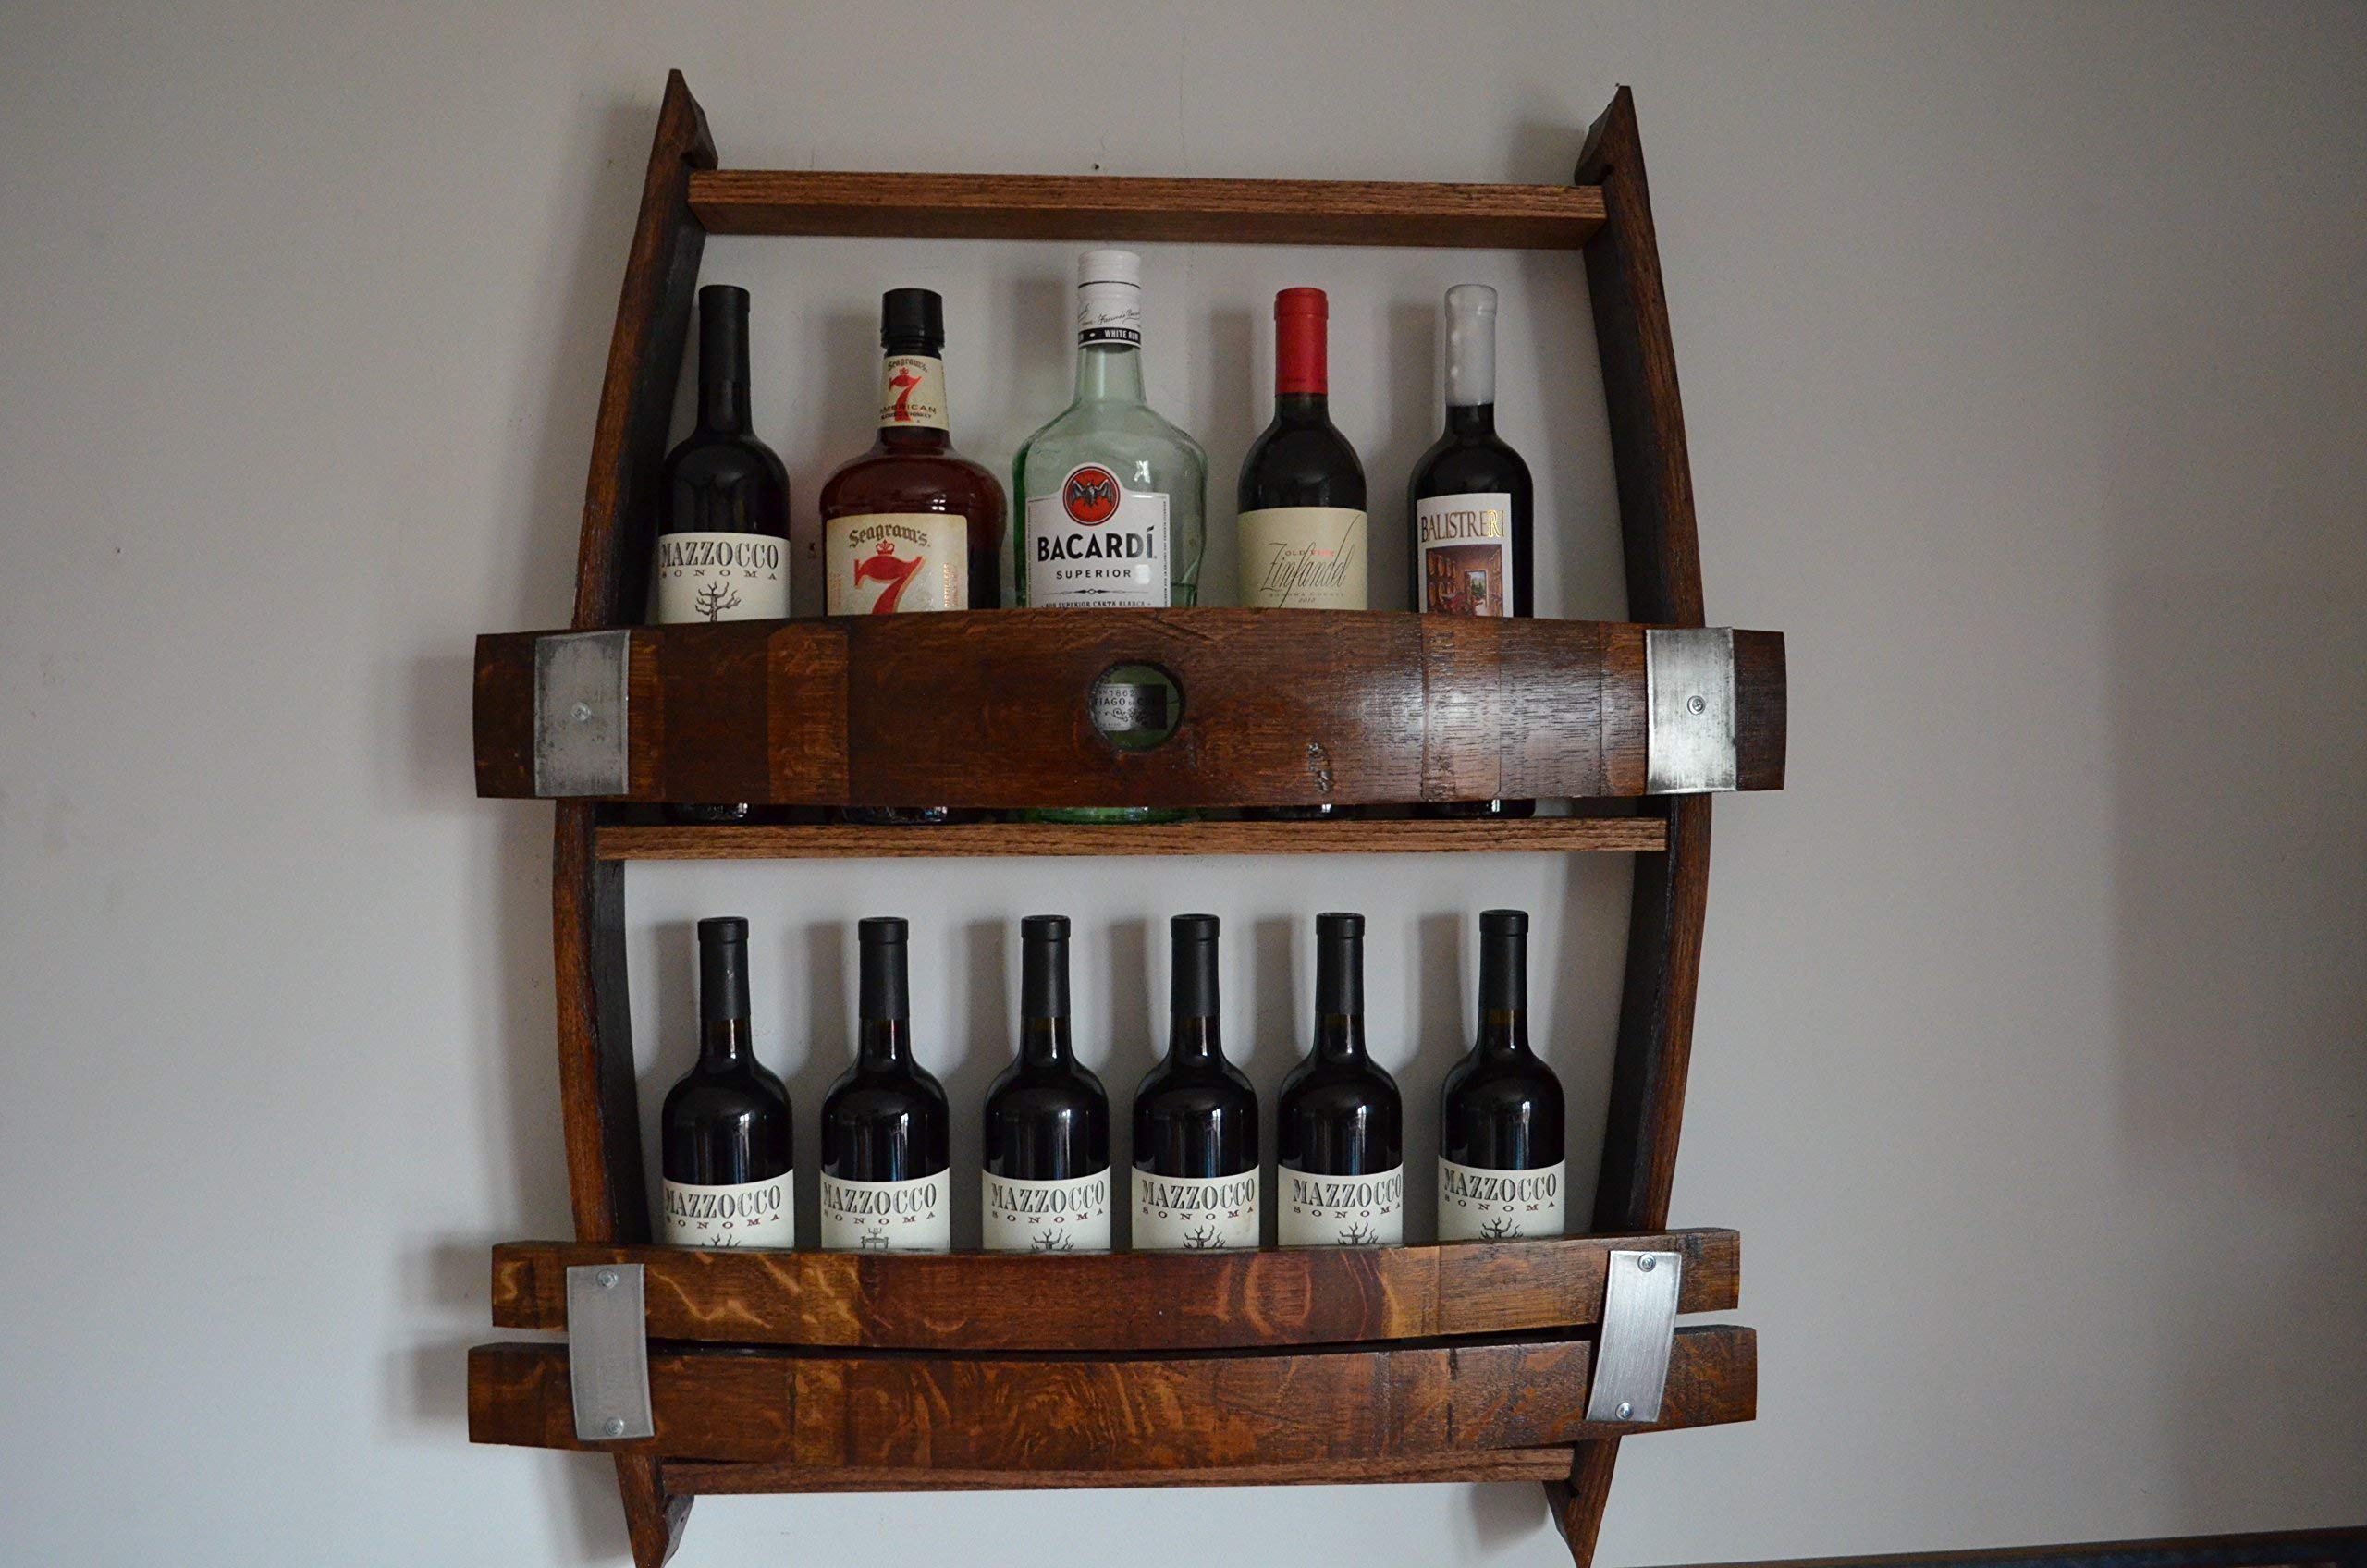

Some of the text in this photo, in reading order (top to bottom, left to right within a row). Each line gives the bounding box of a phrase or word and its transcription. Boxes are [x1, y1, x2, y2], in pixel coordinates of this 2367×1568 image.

[1104, 328, 1127, 339] WHITE
[880, 404, 936, 414] AMERICAN
[889, 374, 922, 423] 7
[848, 523, 928, 549] Seagram's
[1421, 509, 1505, 544] BALISTRERI
[1037, 525, 1154, 562] BACARDÍ
[660, 541, 779, 570] MAZZOCCO
[661, 569, 778, 580] SONOMA
[854, 555, 925, 614] 7
[1056, 568, 1132, 580] SUPERIOR
[1058, 600, 1091, 608] SUPERIOR
[1094, 697, 1126, 706] TIAGO
[1142, 1177, 1255, 1210] MAZZOCCO
[1293, 1173, 1402, 1207] MAZZOCCO
[1444, 1167, 1557, 1203] MAZZOCCO
[666, 1184, 781, 1219] MAZZOCCO
[823, 1182, 937, 1216] MAZZOCCO
[991, 1180, 1105, 1214] MAZZOCCO
[1444, 1194, 1555, 1213] SONOMA
[667, 1214, 780, 1229] SONOMA
[824, 1209, 936, 1226] SONOMA
[992, 1208, 1104, 1224] SONOMA
[1142, 1206, 1254, 1220] SONOMA
[1294, 1202, 1401, 1219] SONOMA
